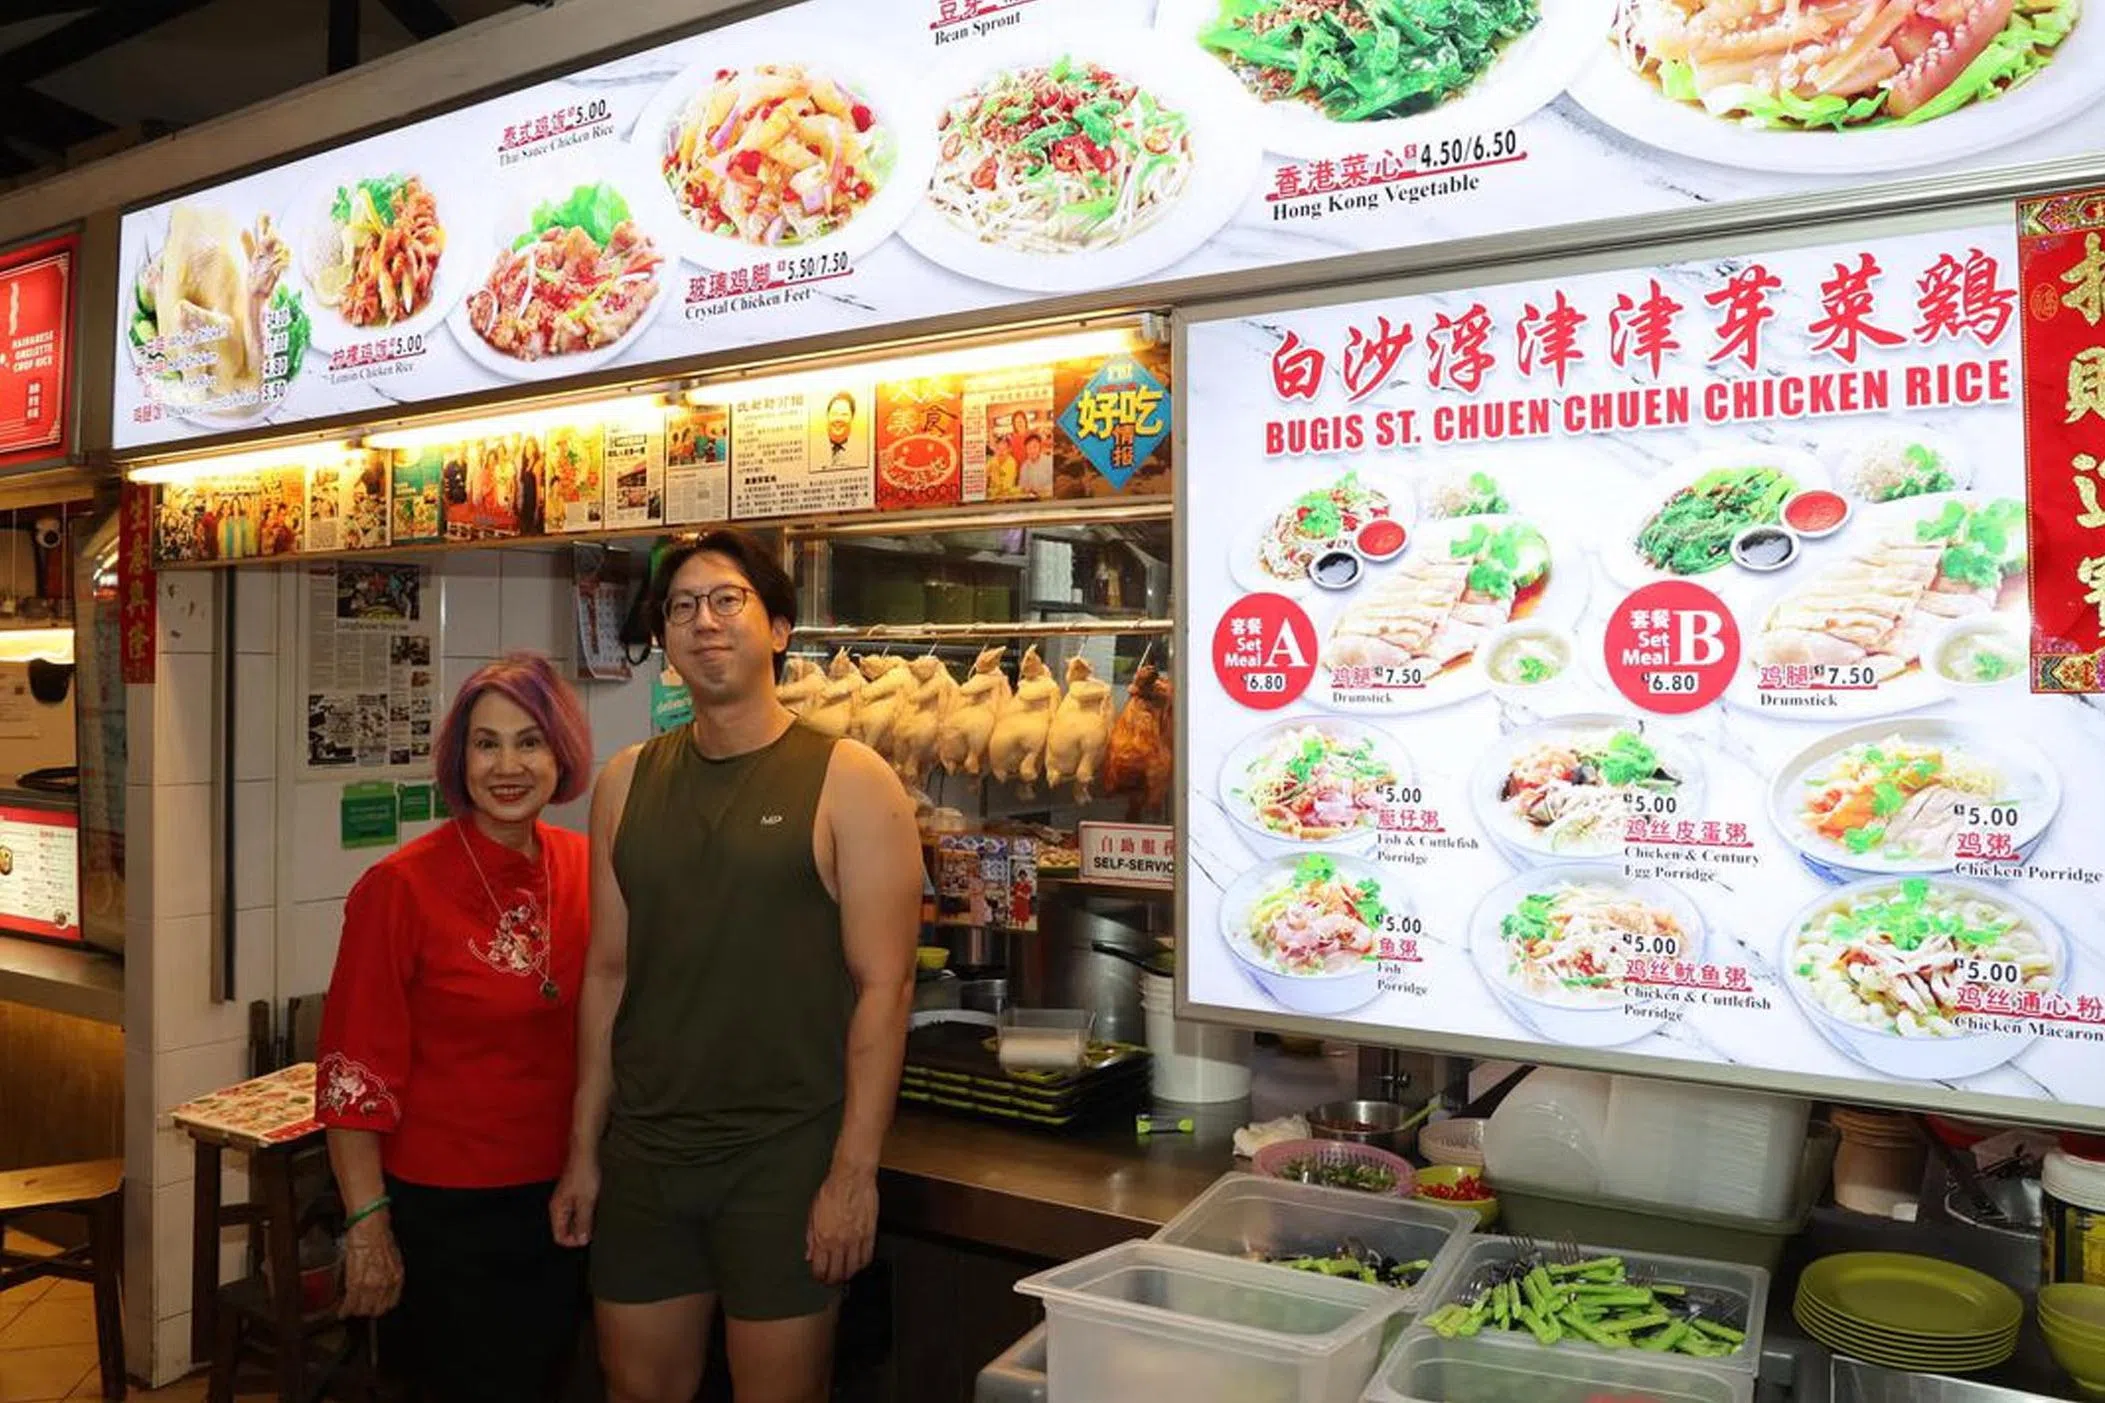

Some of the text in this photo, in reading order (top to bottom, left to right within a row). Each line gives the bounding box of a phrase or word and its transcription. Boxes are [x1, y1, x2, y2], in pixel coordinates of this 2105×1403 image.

[935, 12, 1020, 45] Bean Sprout
[550, 132, 590, 151] Chicken
[592, 125, 614, 140] Rice
[1275, 129, 1516, 198] 香港菜心 4.50/6.50
[1273, 173, 1480, 221] Hong Kong Vegetable
[685, 287, 811, 321] Crystal Chicken Feet
[1077, 384, 1164, 439] 好吃
[1265, 358, 2010, 456] BUGIS ST. CHUEN CHUEN CHICKEN RICE
[1630, 609, 1671, 630] 套餐
[1224, 618, 1310, 669] Meal A
[1237, 637, 1262, 653] Set
[1622, 609, 1726, 666] Meal B
[1638, 632, 1671, 649] Set
[1250, 674, 1284, 691] 6.80
[1385, 667, 1422, 684] 7.50
[1652, 674, 1696, 692] 6.80
[1760, 666, 1875, 687] 鸡腿 7.50
[1332, 691, 1394, 704] Drumstick
[1760, 693, 1838, 707] Drumstick
[1385, 787, 1422, 804] 5.00
[1635, 795, 1677, 814] 5.00
[1968, 806, 2018, 827] 5.00
[1626, 818, 1748, 843] 鸡丝皮蛋粥
[1377, 833, 1480, 850] Fish & Cuttlefish
[1957, 831, 2012, 856] 鸡粥
[1093, 857, 1174, 874] SELF-SERVIC
[1377, 851, 1428, 866] Porridge
[1625, 845, 1760, 868] Chicken & Century
[1625, 864, 1716, 883] Egg Porridge
[1955, 862, 2105, 885] Chicken Porridge
[1385, 915, 1422, 935] 5.00
[1379, 937, 1418, 958] 鱼粥
[1635, 935, 1677, 955] 5.00
[1377, 961, 1402, 975] Fish
[1968, 961, 2018, 983] 5.00
[1377, 979, 1428, 996] Porridge
[1624, 985, 1772, 1010] Chicken & Cuttlefish
[1624, 1003, 1684, 1022] Porridge
[1957, 986, 2103, 1020] 鸡丝通心粉
[1954, 1016, 2105, 1042] Chicken Macaron
